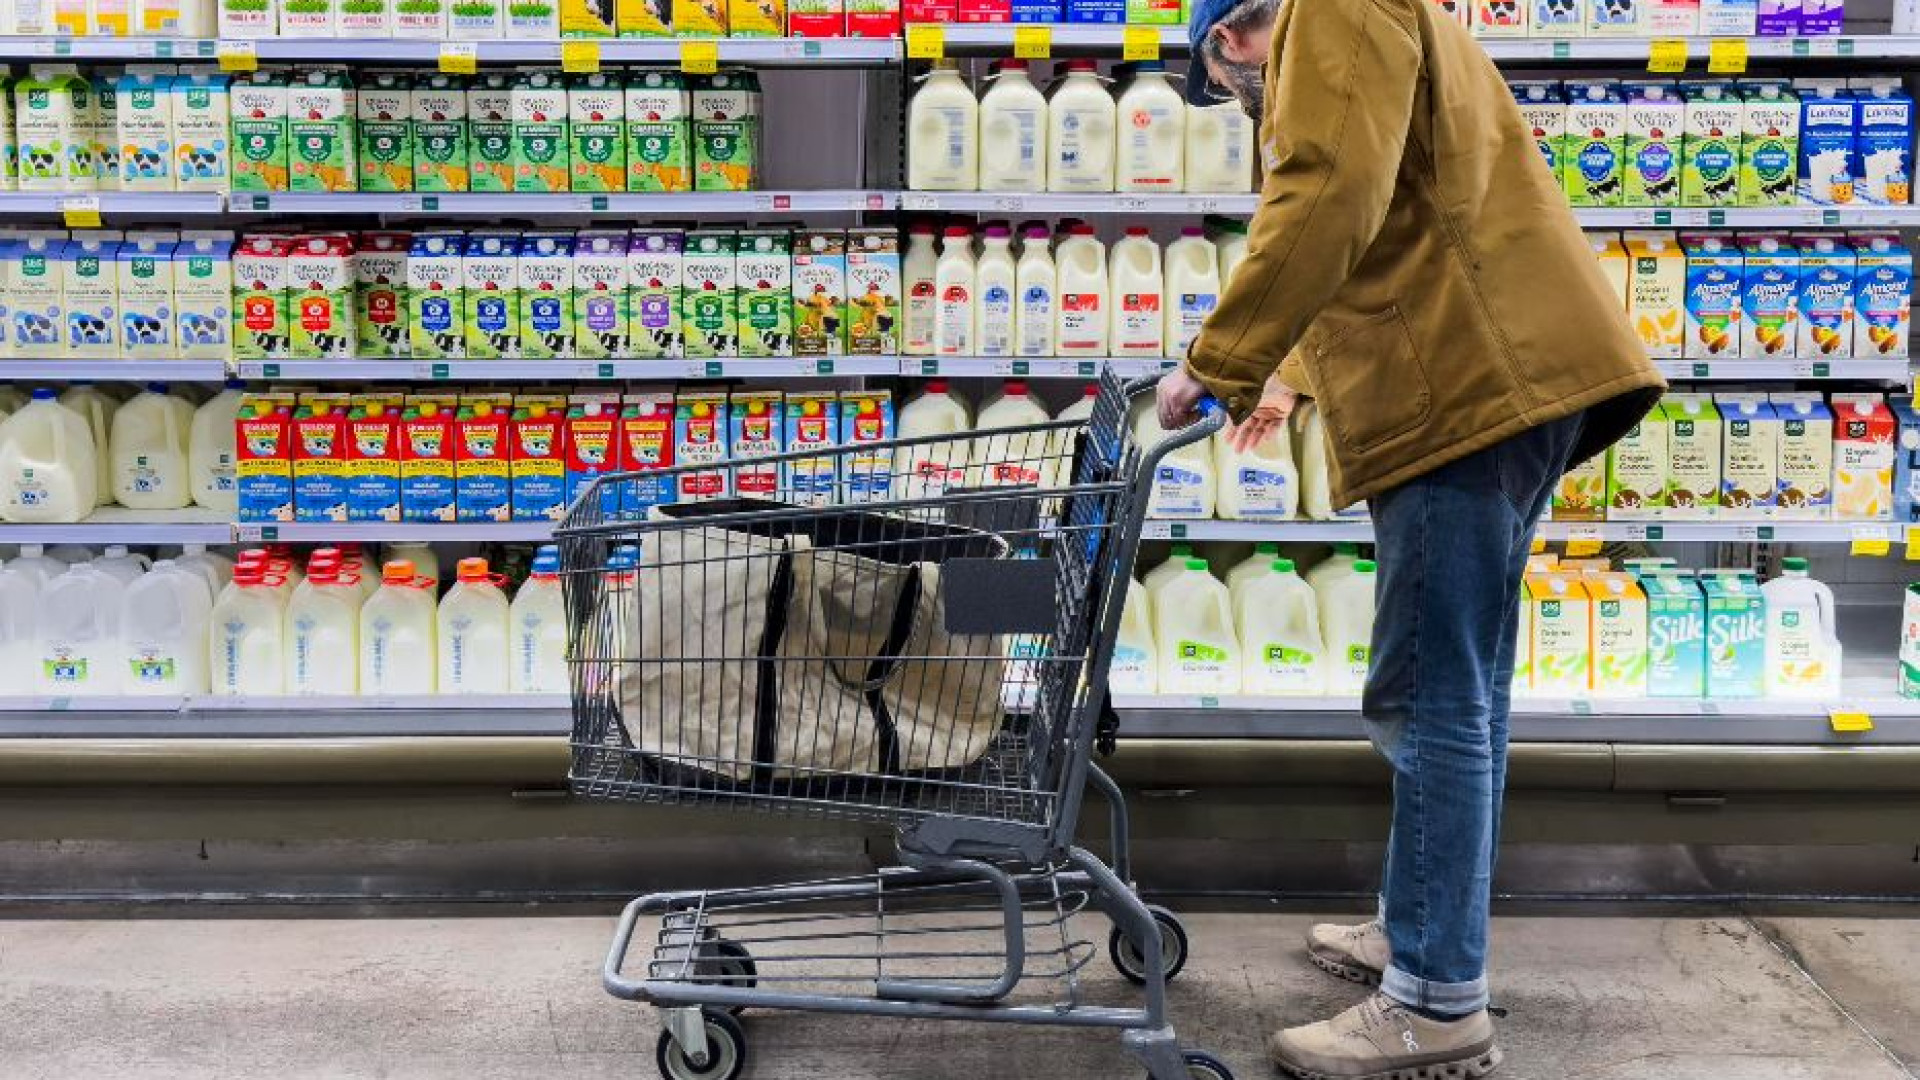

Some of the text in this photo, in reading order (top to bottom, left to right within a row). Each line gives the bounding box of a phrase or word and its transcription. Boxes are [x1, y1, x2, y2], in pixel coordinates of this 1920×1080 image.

[1691, 280, 1740, 297] Almond
[1748, 280, 1797, 297] Almond
[1803, 280, 1852, 297] Almond
[1860, 280, 1908, 297] Almond
[1650, 612, 1704, 649] Silk
[1710, 612, 1765, 648] Silk
